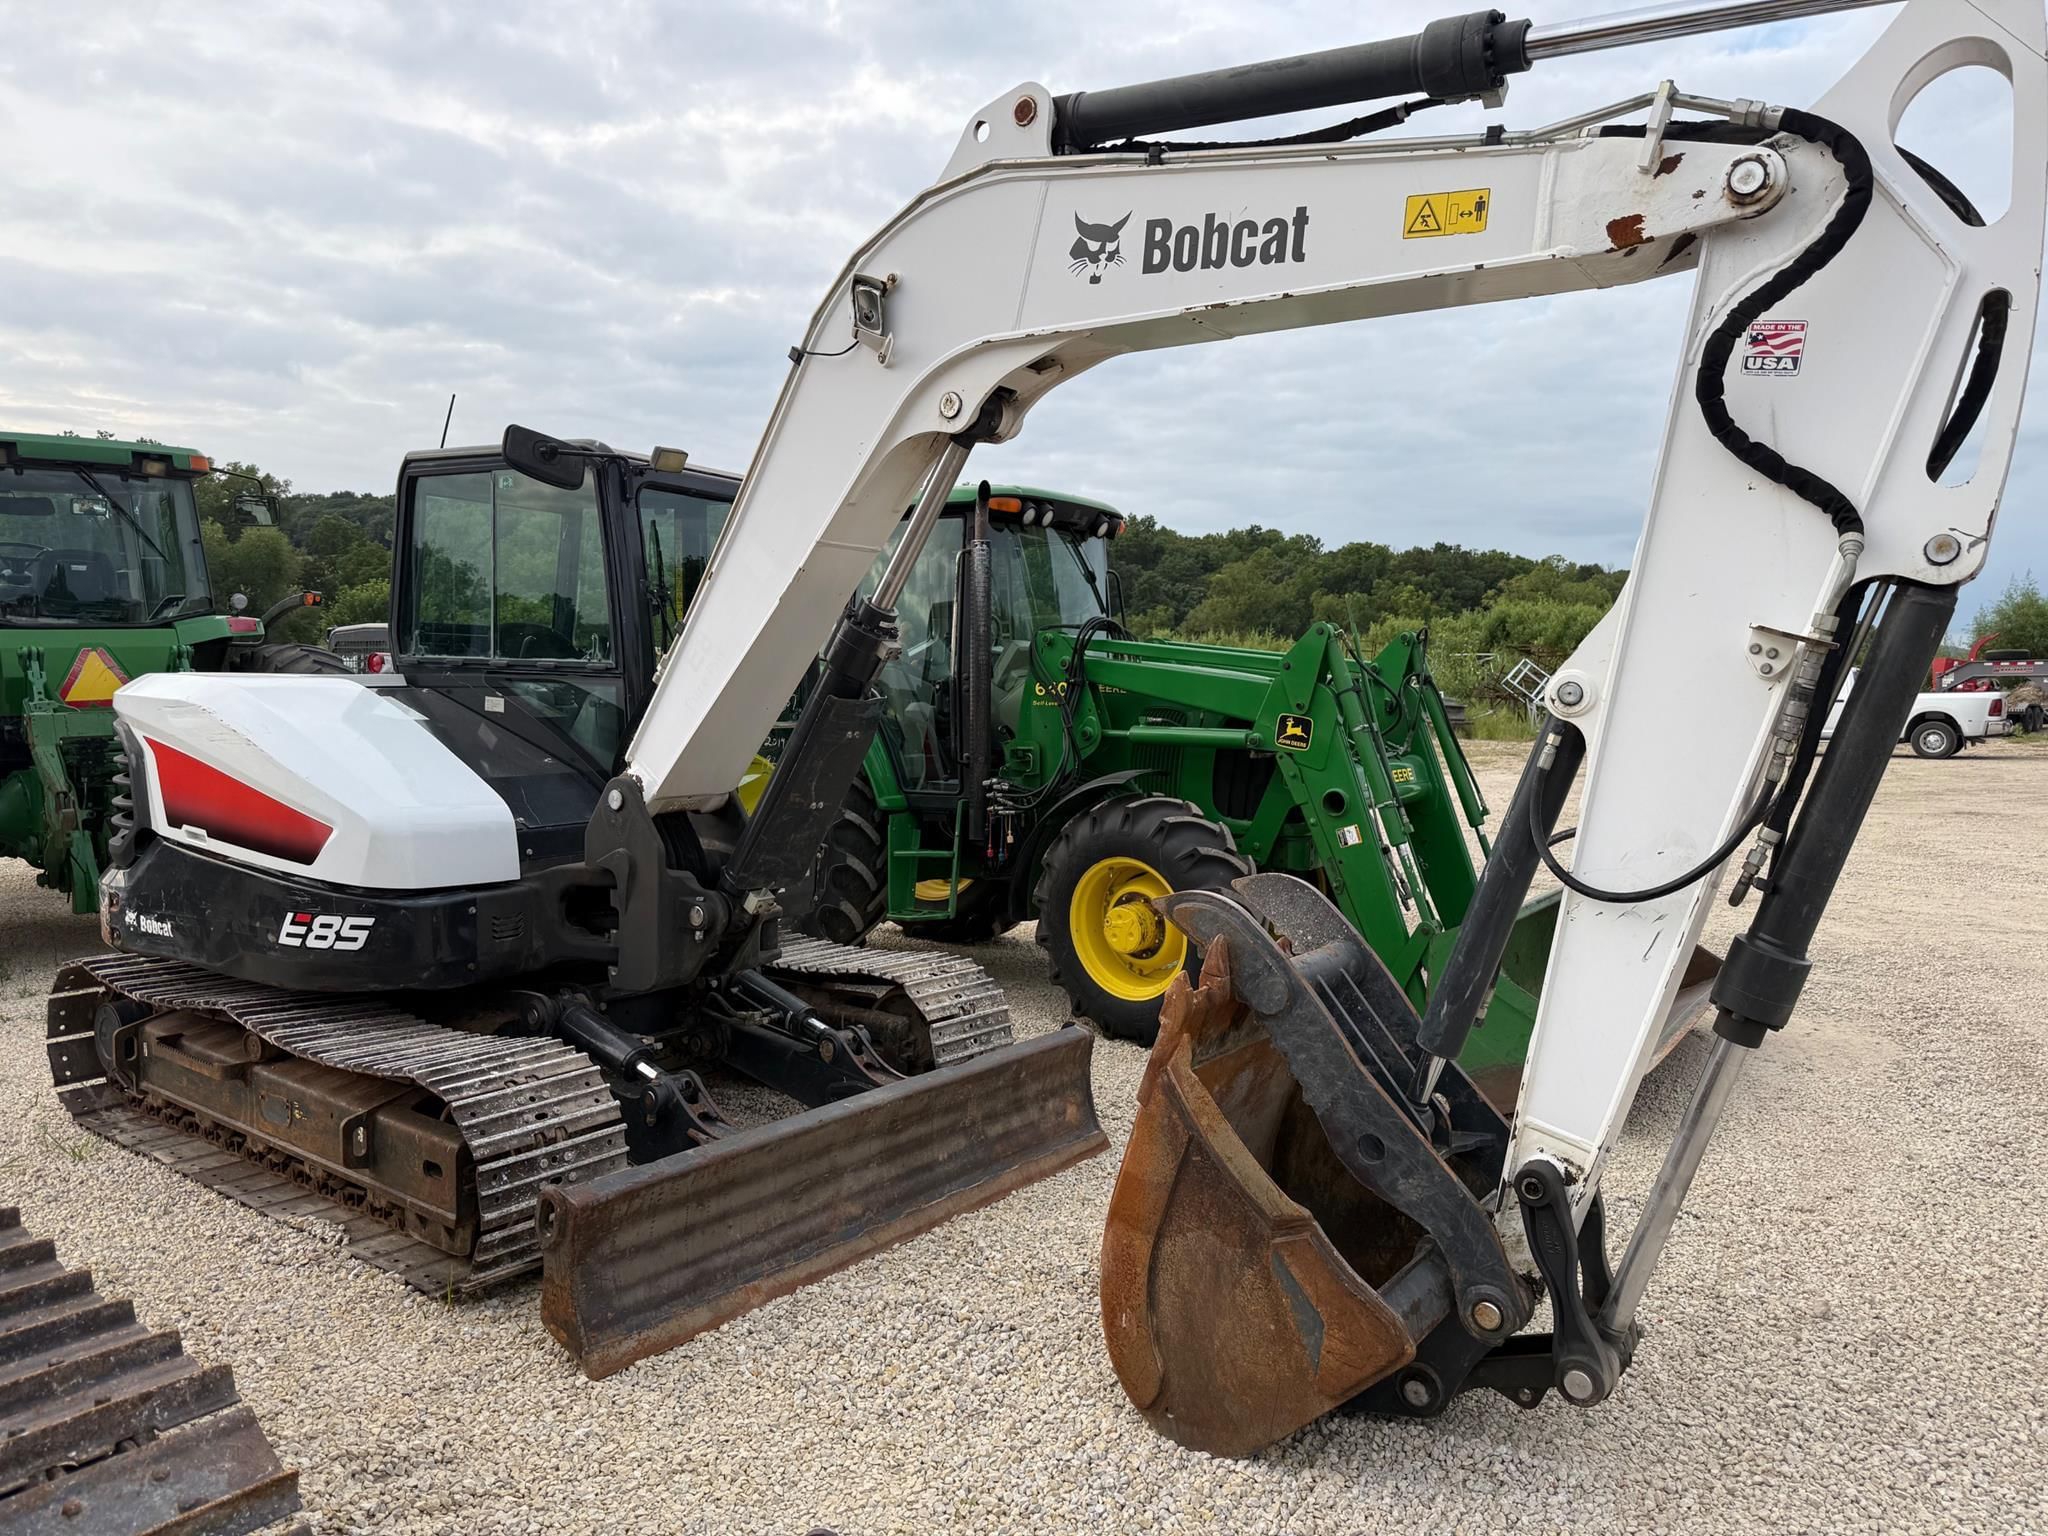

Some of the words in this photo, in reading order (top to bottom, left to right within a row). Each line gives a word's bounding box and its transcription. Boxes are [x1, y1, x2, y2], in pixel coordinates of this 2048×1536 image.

[1142, 206, 1309, 275] Bobcat
[1747, 357, 1794, 369] USA
[1291, 740, 1307, 748] DEERE
[1391, 767, 1414, 782] EERE
[140, 914, 174, 938] Bobcat
[278, 912, 376, 951] E85
